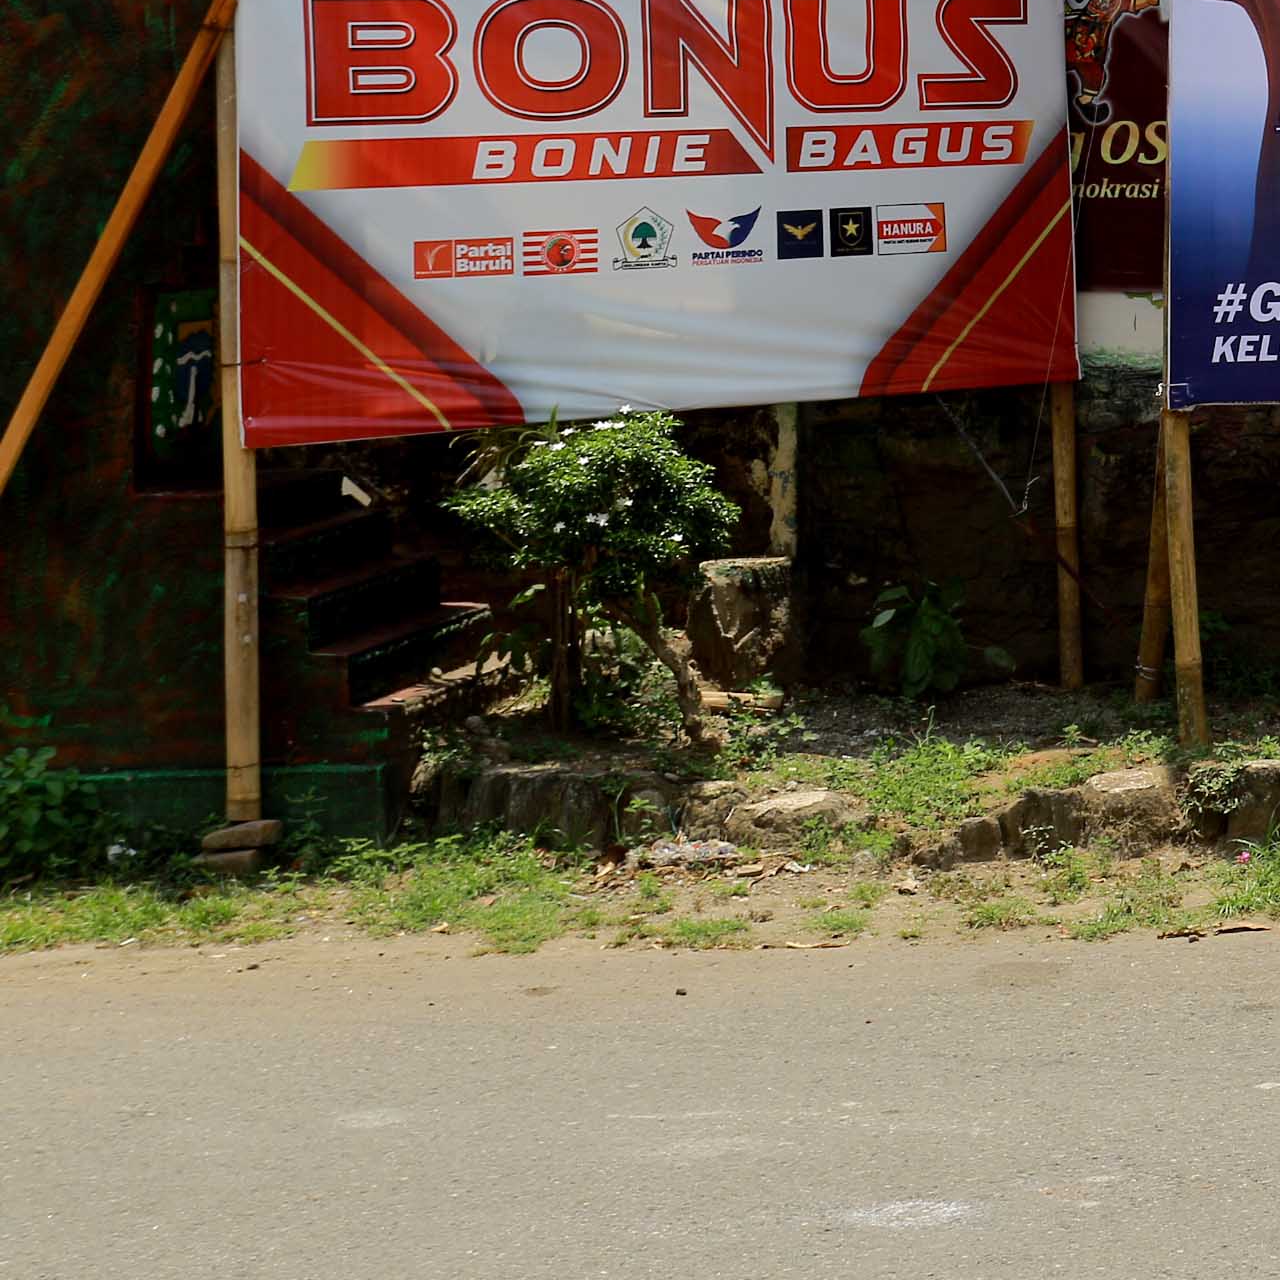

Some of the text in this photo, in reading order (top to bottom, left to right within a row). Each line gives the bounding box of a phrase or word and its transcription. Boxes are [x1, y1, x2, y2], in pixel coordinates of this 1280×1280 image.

[797, 123, 1017, 169] BAGUS
[470, 132, 712, 180] BONIE
[883, 221, 934, 236] HANURA
[456, 242, 512, 259] Partai
[692, 249, 764, 260] PARTAI PERINDO
[456, 257, 512, 273] Buruh
